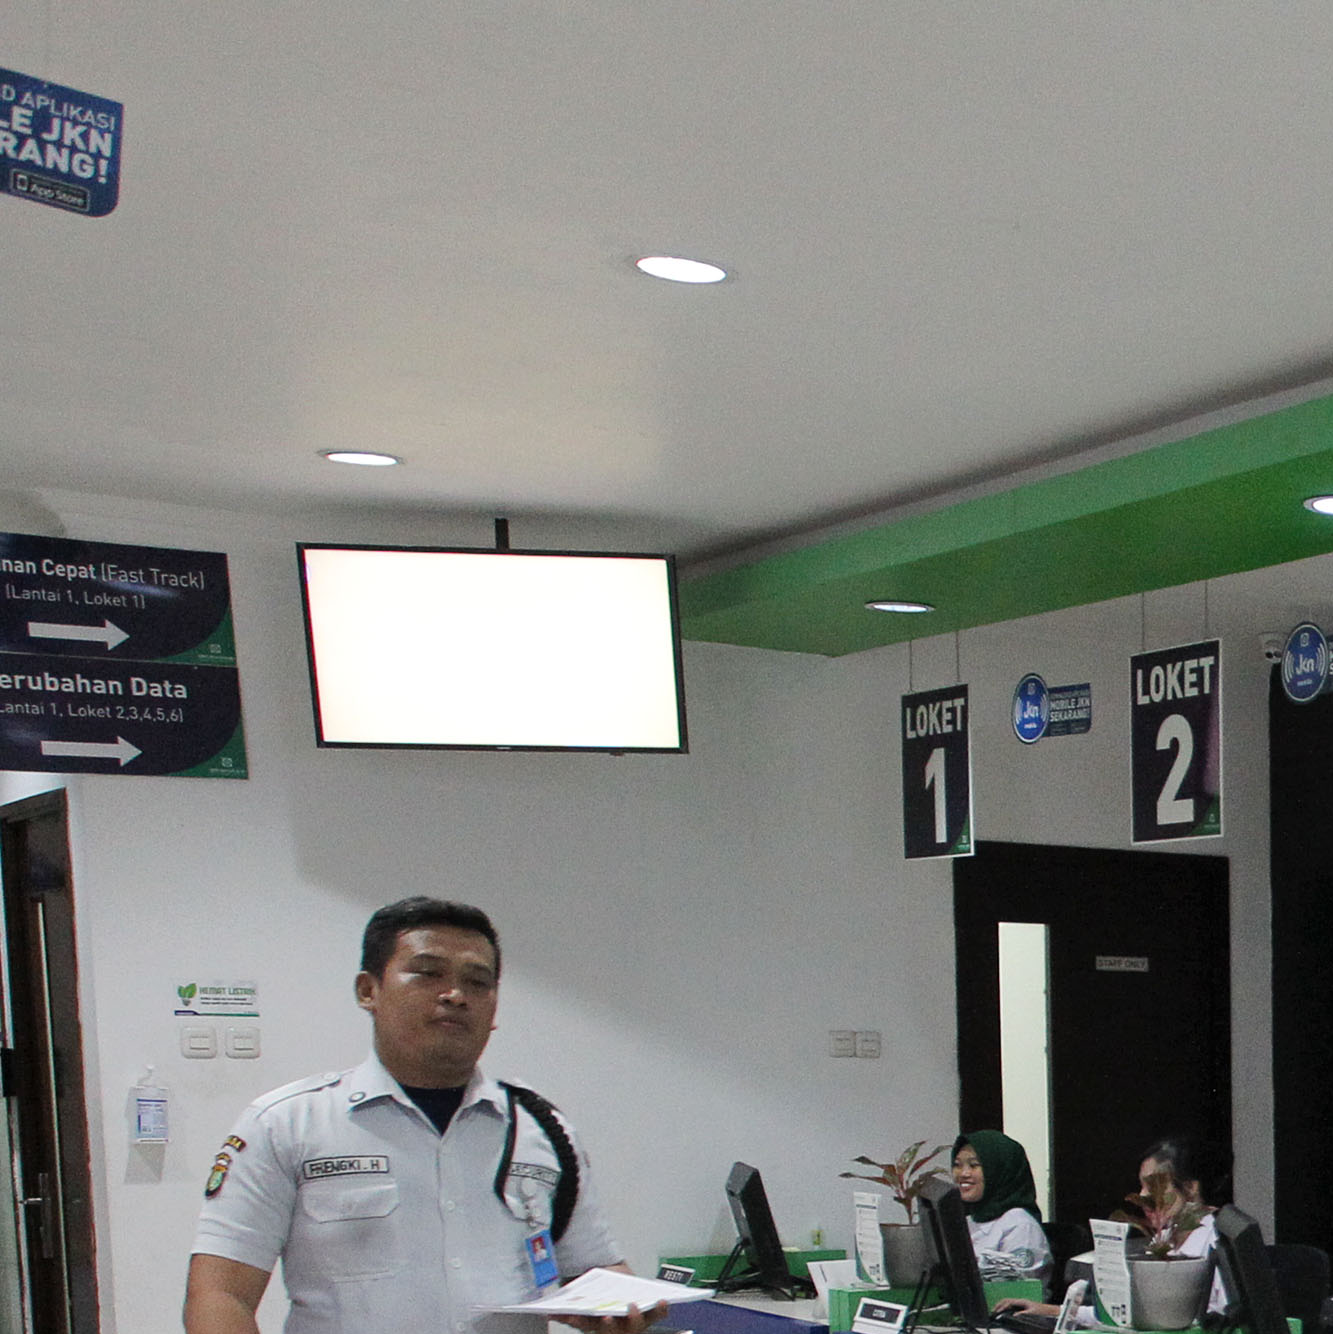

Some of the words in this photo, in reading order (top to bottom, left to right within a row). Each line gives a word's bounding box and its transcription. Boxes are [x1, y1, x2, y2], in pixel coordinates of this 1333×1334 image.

[21, 91, 115, 131] APLIKASI
[41, 117, 112, 158] JKN
[0, 559, 37, 574] nan
[42, 559, 96, 582] Cepat
[101, 563, 145, 584] (Fast
[150, 568, 205, 590] Track)
[5, 583, 61, 602] (Lantai
[83, 592, 128, 608] Loket
[0, 672, 123, 695] erubahan
[131, 677, 187, 699] Data
[1136, 656, 1215, 705] LOKET
[68, 705, 112, 718] Loket
[905, 697, 965, 739] LOKET
[1156, 713, 1194, 825] 2
[925, 747, 947, 844] 1
